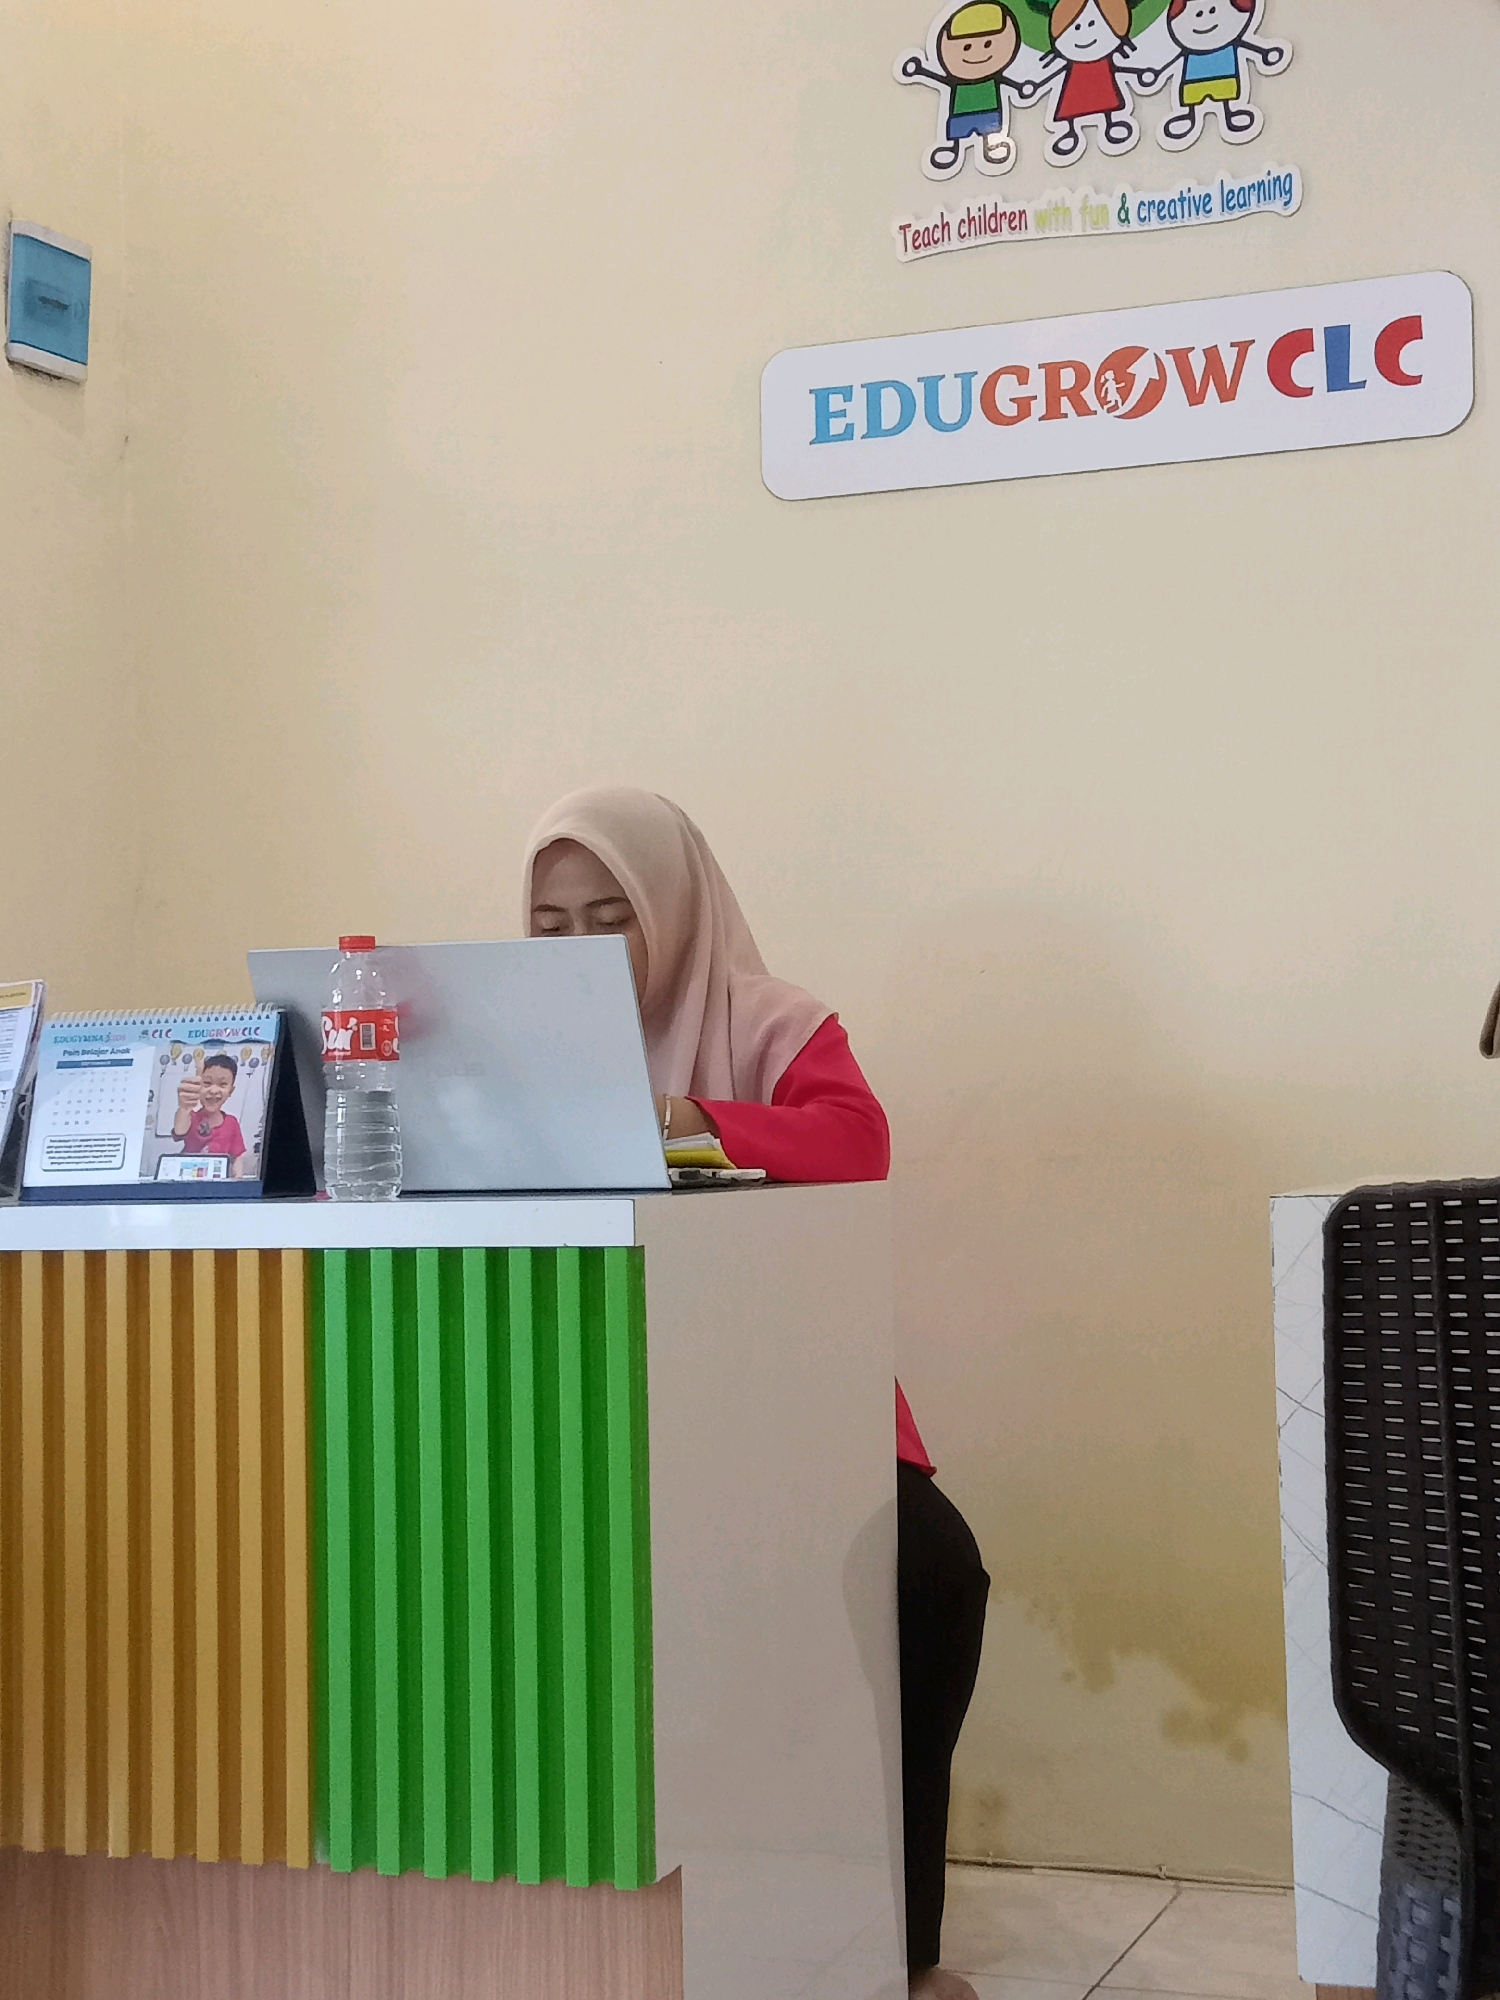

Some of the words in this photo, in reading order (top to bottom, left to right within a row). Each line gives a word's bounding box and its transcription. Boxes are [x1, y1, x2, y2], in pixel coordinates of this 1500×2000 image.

[899, 212, 950, 253] Teach
[957, 202, 1028, 240] children
[1034, 201, 1072, 232] with
[1080, 198, 1110, 231] fun
[1117, 193, 1131, 226] &
[1136, 187, 1213, 223] creative
[1219, 170, 1293, 214] learning
[809, 340, 1255, 445] EDUGROW
[1266, 315, 1423, 399] CLC
